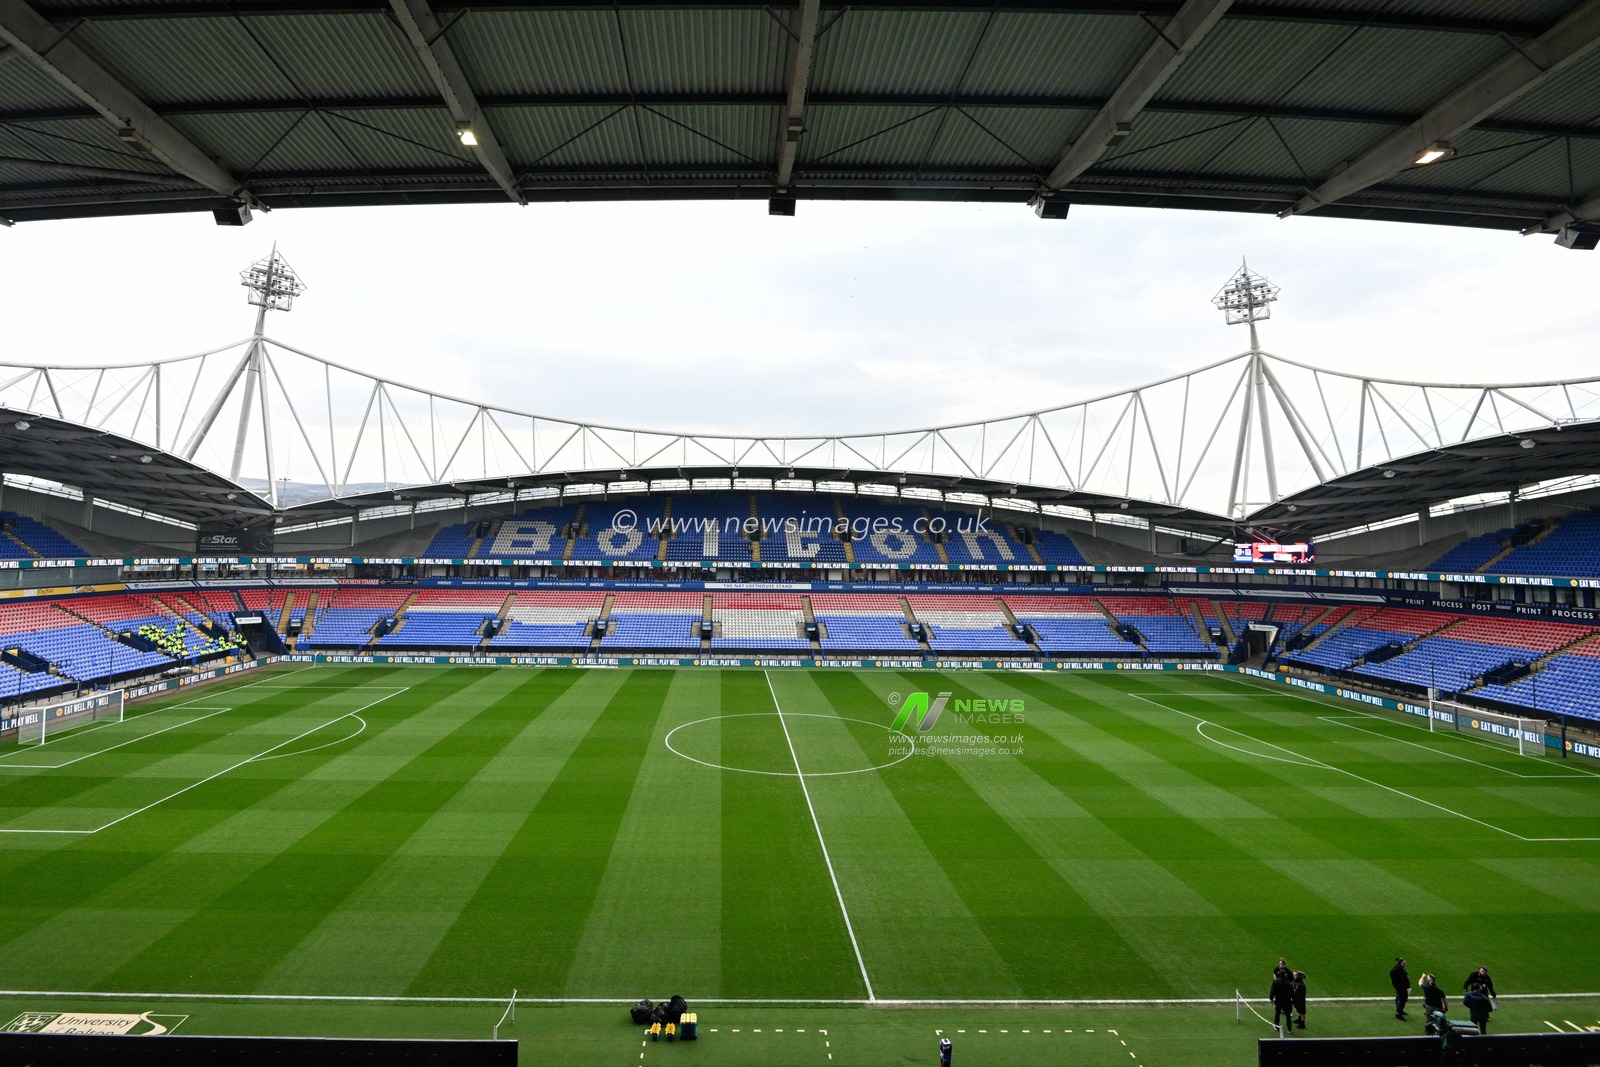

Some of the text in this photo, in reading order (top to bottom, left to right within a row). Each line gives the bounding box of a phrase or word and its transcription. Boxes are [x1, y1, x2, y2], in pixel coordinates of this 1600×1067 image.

[1516, 607, 1541, 615] PRINT
[1552, 610, 1594, 619] PROCESS
[149, 685, 158, 693] PLAY
[158, 682, 168, 691] WELL
[1362, 694, 1371, 703] PLAY
[1372, 696, 1383, 706] WELL
[65, 704, 73, 714] EAT
[1405, 704, 1413, 713] EAT
[1440, 712, 1453, 723] WELL
[25, 714, 38, 725] WELL
[1481, 721, 1490, 732] EAT
[1492, 724, 1508, 736] WELL.
[1524, 731, 1540, 744] WELL
[1575, 742, 1600, 758] EAT WE
[57, 1016, 134, 1028] University
